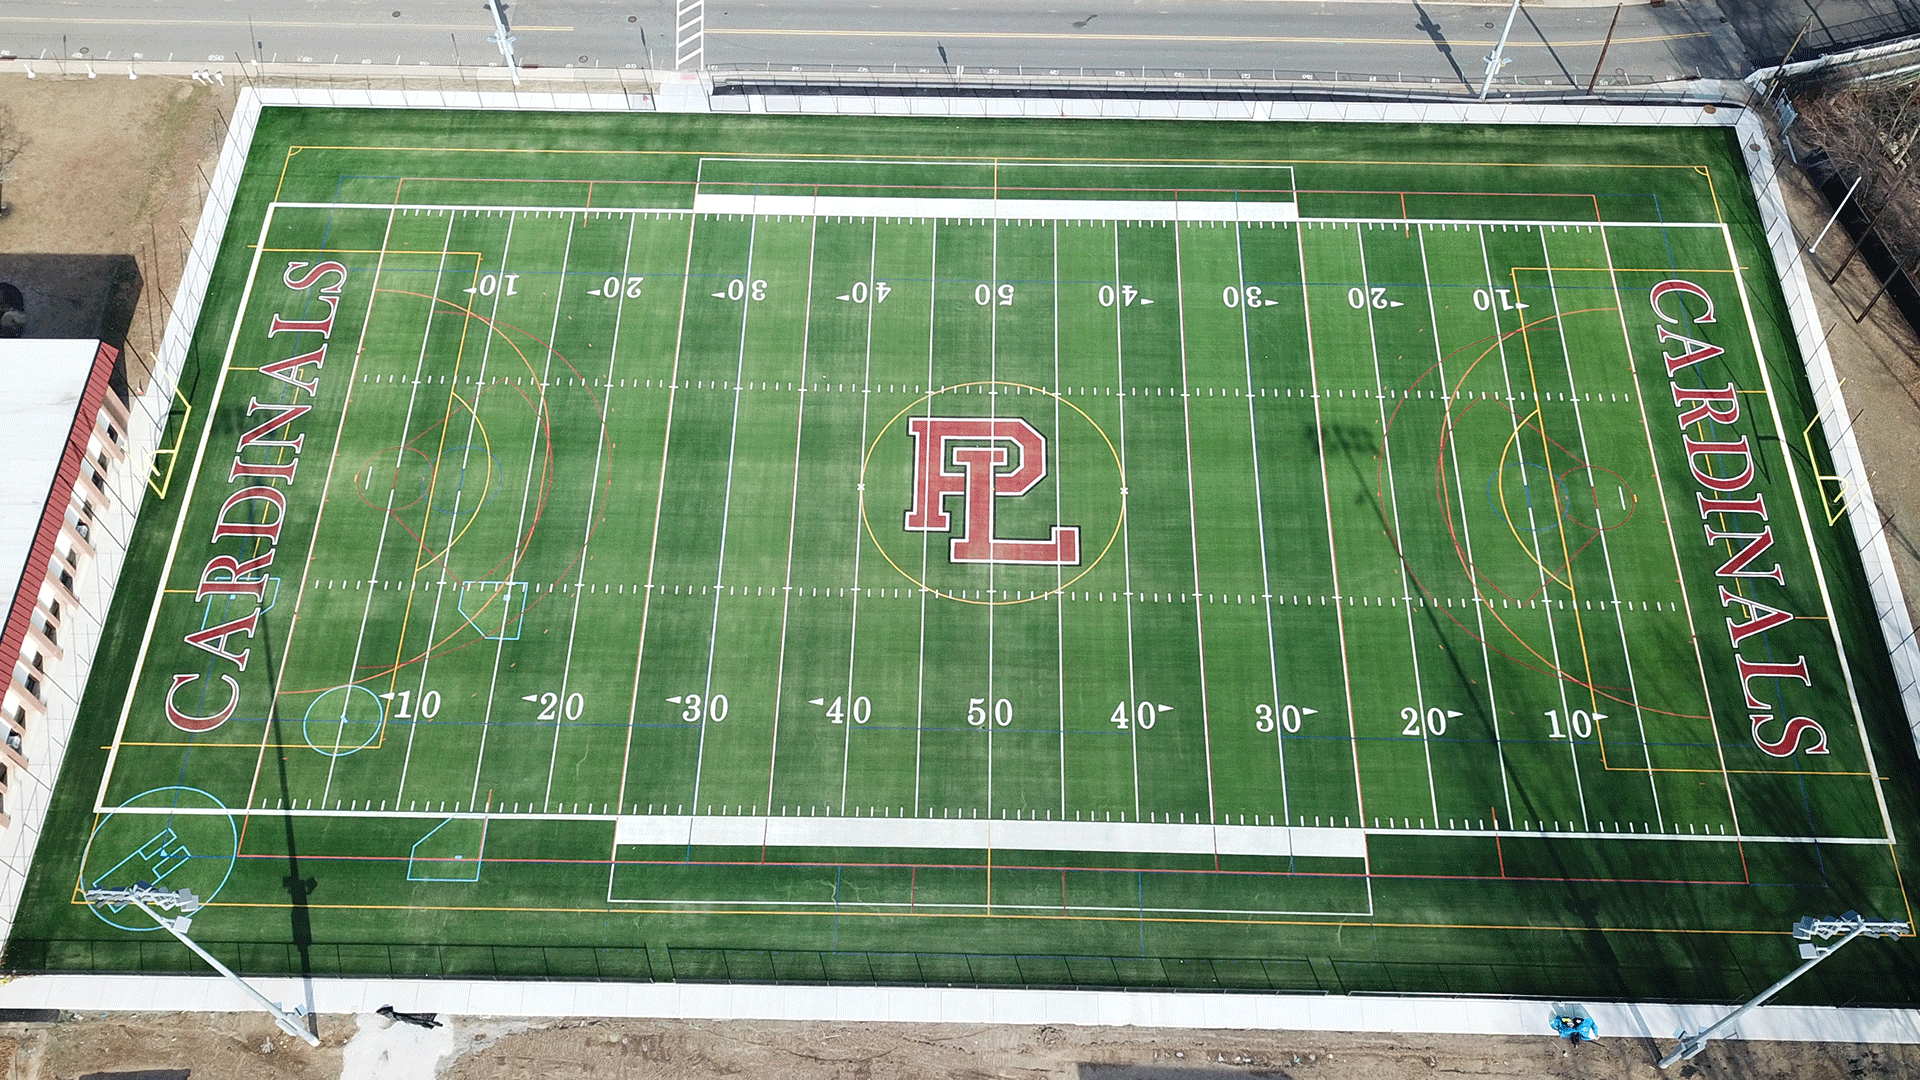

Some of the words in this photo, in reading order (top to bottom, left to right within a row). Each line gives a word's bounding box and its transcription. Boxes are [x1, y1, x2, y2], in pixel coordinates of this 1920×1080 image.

[479, 274, 520, 297] 10
[603, 277, 646, 300] 20
[727, 278, 767, 301] 30
[852, 281, 892, 304] 40
[974, 283, 1014, 306] 50
[1098, 284, 1140, 307] 40
[1223, 285, 1263, 308] 30
[1348, 286, 1388, 309] 20
[1473, 288, 1516, 311] 10
[164, 260, 348, 733] CARDINALS
[904, 416, 1081, 565] PL
[1649, 279, 1829, 759] CARDINALS
[395, 690, 441, 718] 10
[536, 692, 584, 721] 20
[682, 694, 729, 722] 30
[825, 695, 871, 724] 40
[967, 697, 1014, 726] 50
[1111, 700, 1156, 730] 40
[1255, 704, 1302, 733] 30
[1401, 706, 1447, 736] 20
[1546, 709, 1591, 739] 10
